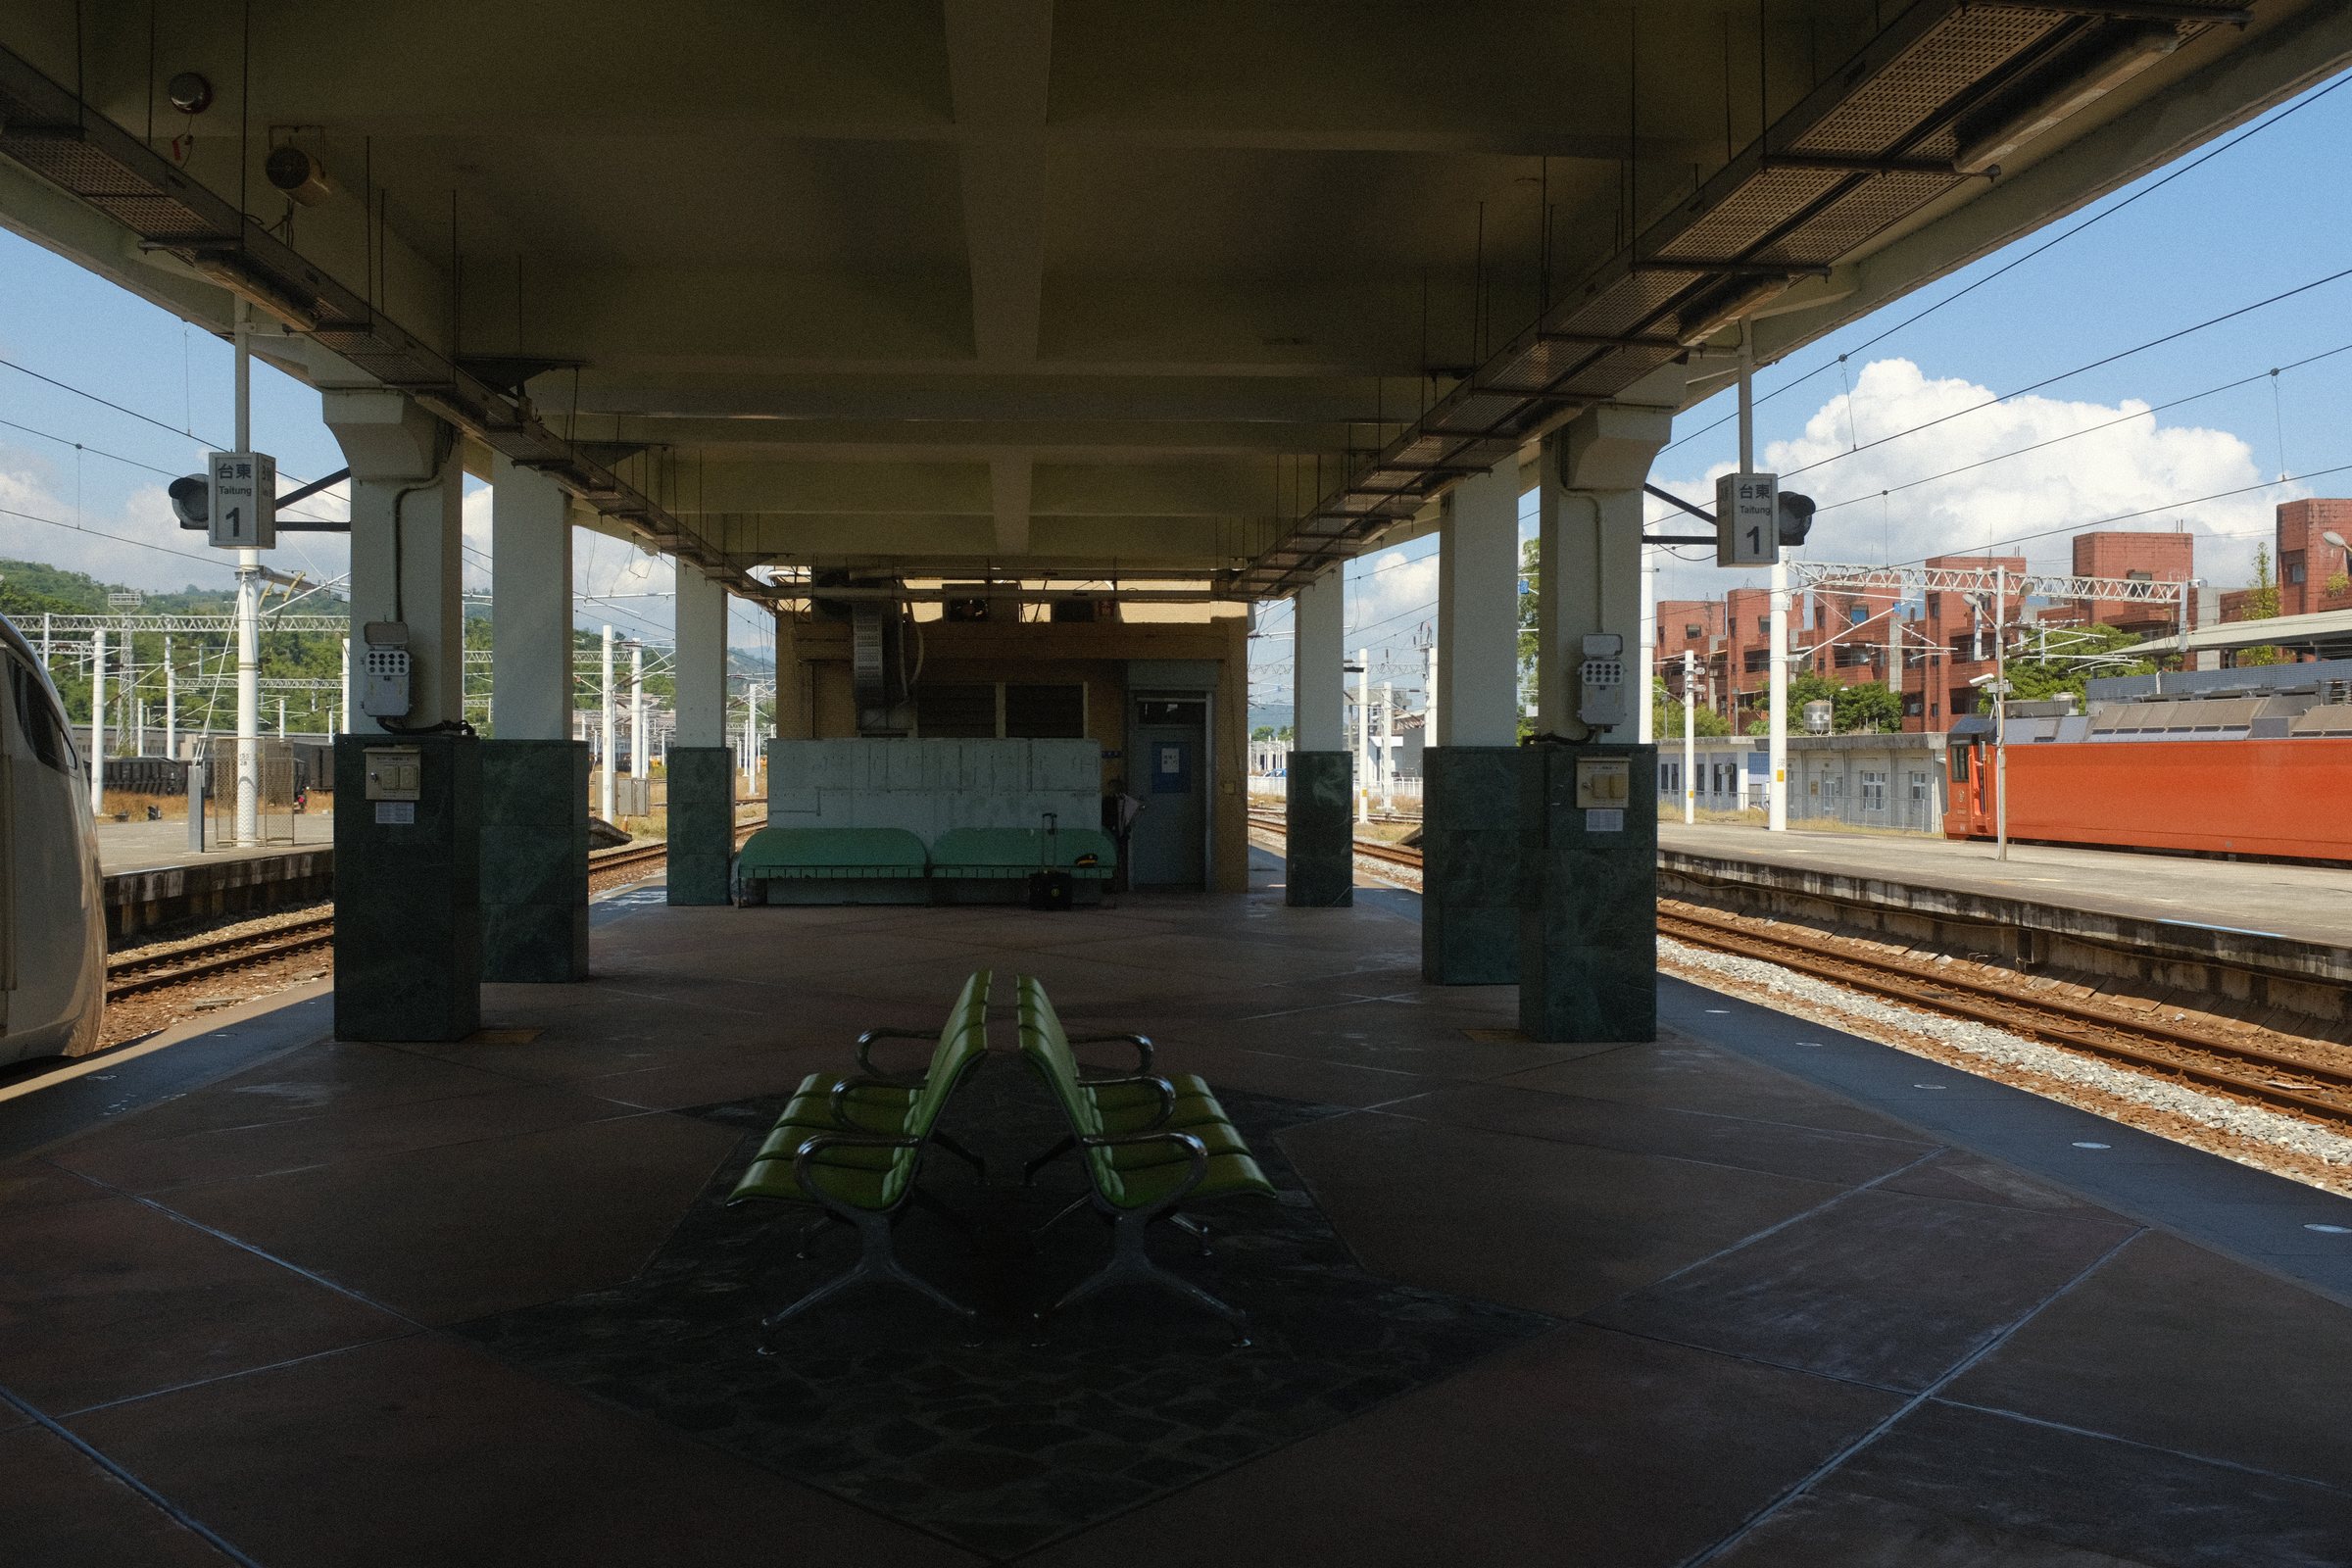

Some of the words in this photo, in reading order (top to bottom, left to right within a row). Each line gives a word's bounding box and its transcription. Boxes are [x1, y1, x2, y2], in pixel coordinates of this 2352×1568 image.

[219, 464, 251, 479] 台東
[219, 486, 252, 497] Taitung
[1740, 484, 1770, 499] 台東
[1740, 505, 1772, 516] Taitung
[225, 508, 239, 537] 1
[1746, 526, 1759, 555] 1
